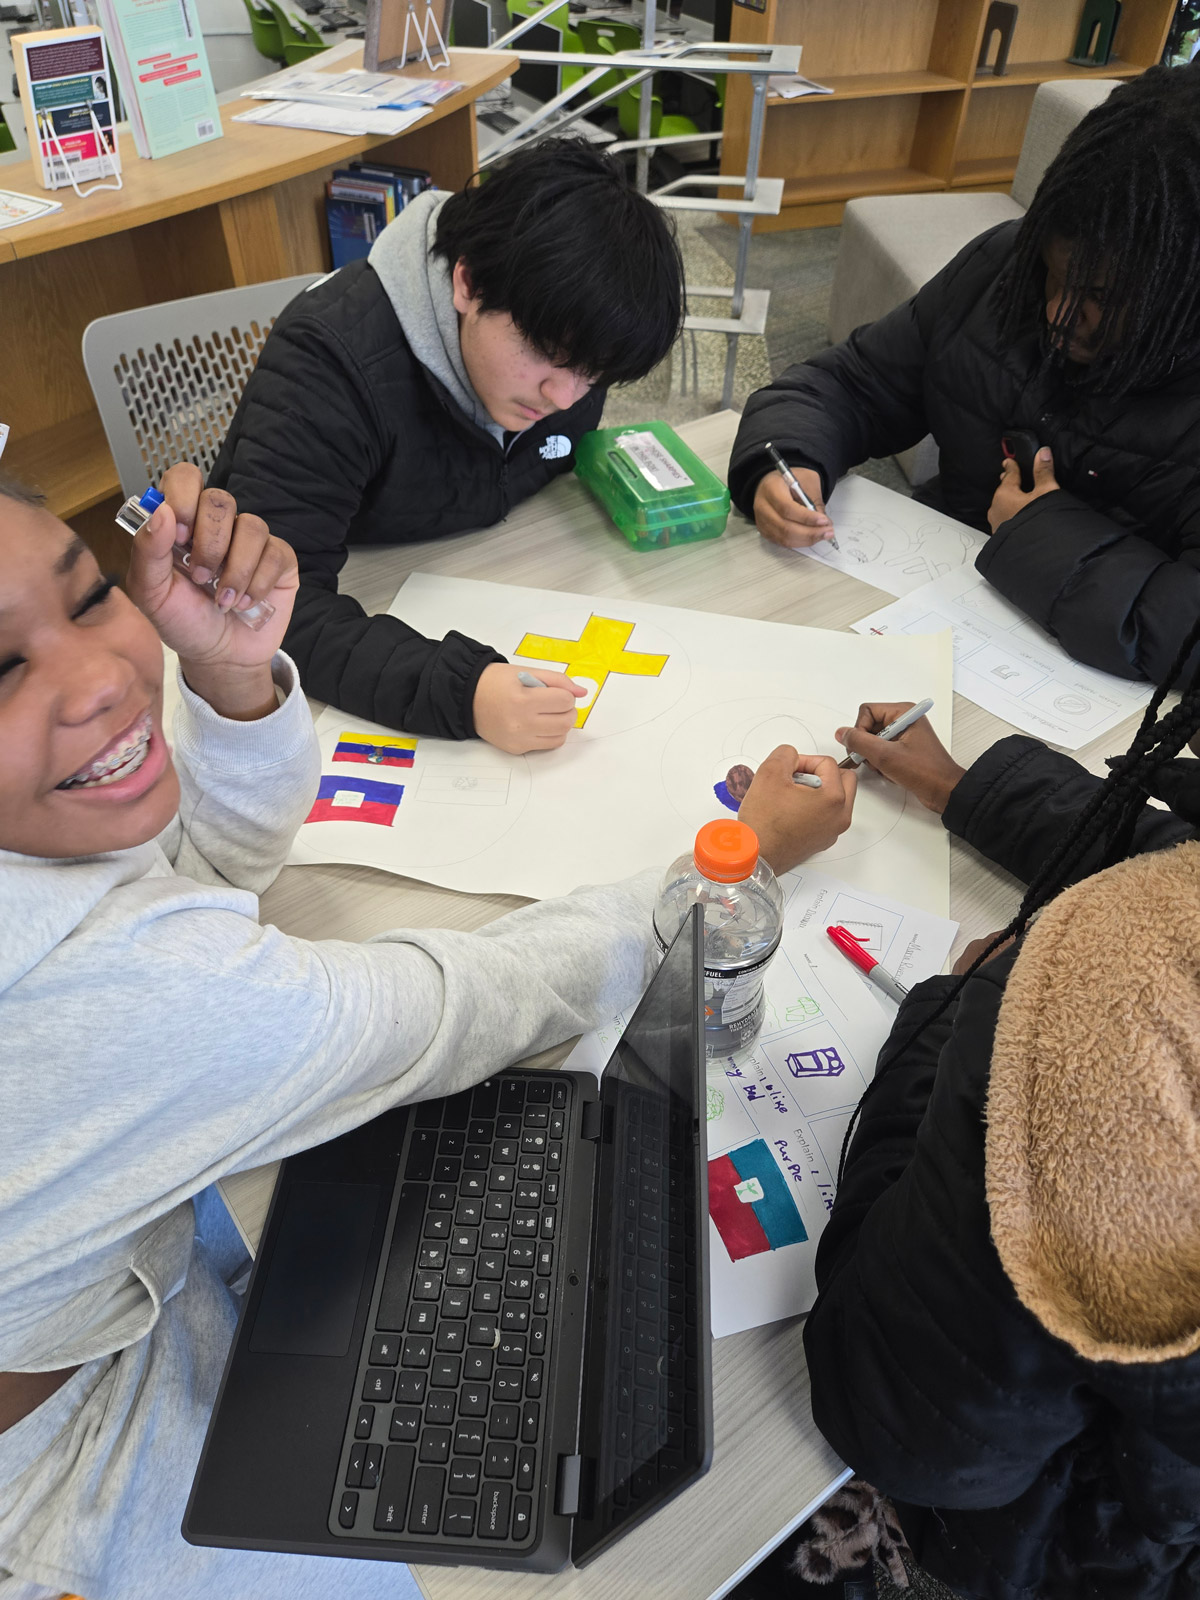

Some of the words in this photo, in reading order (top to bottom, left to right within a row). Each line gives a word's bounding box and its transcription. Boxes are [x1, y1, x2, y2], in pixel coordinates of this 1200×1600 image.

[710, 826, 742, 852] G
[813, 888, 829, 910] Explain
[704, 970, 722, 978] FUEL
[793, 1128, 815, 1163] Explain
[817, 1184, 835, 1216] lik
[380, 1344, 389, 1355] alt
[374, 1378, 382, 1391] ctrl
[385, 1505, 395, 1523] shift
[421, 1504, 429, 1526] enter
[489, 1490, 500, 1531] backspace
